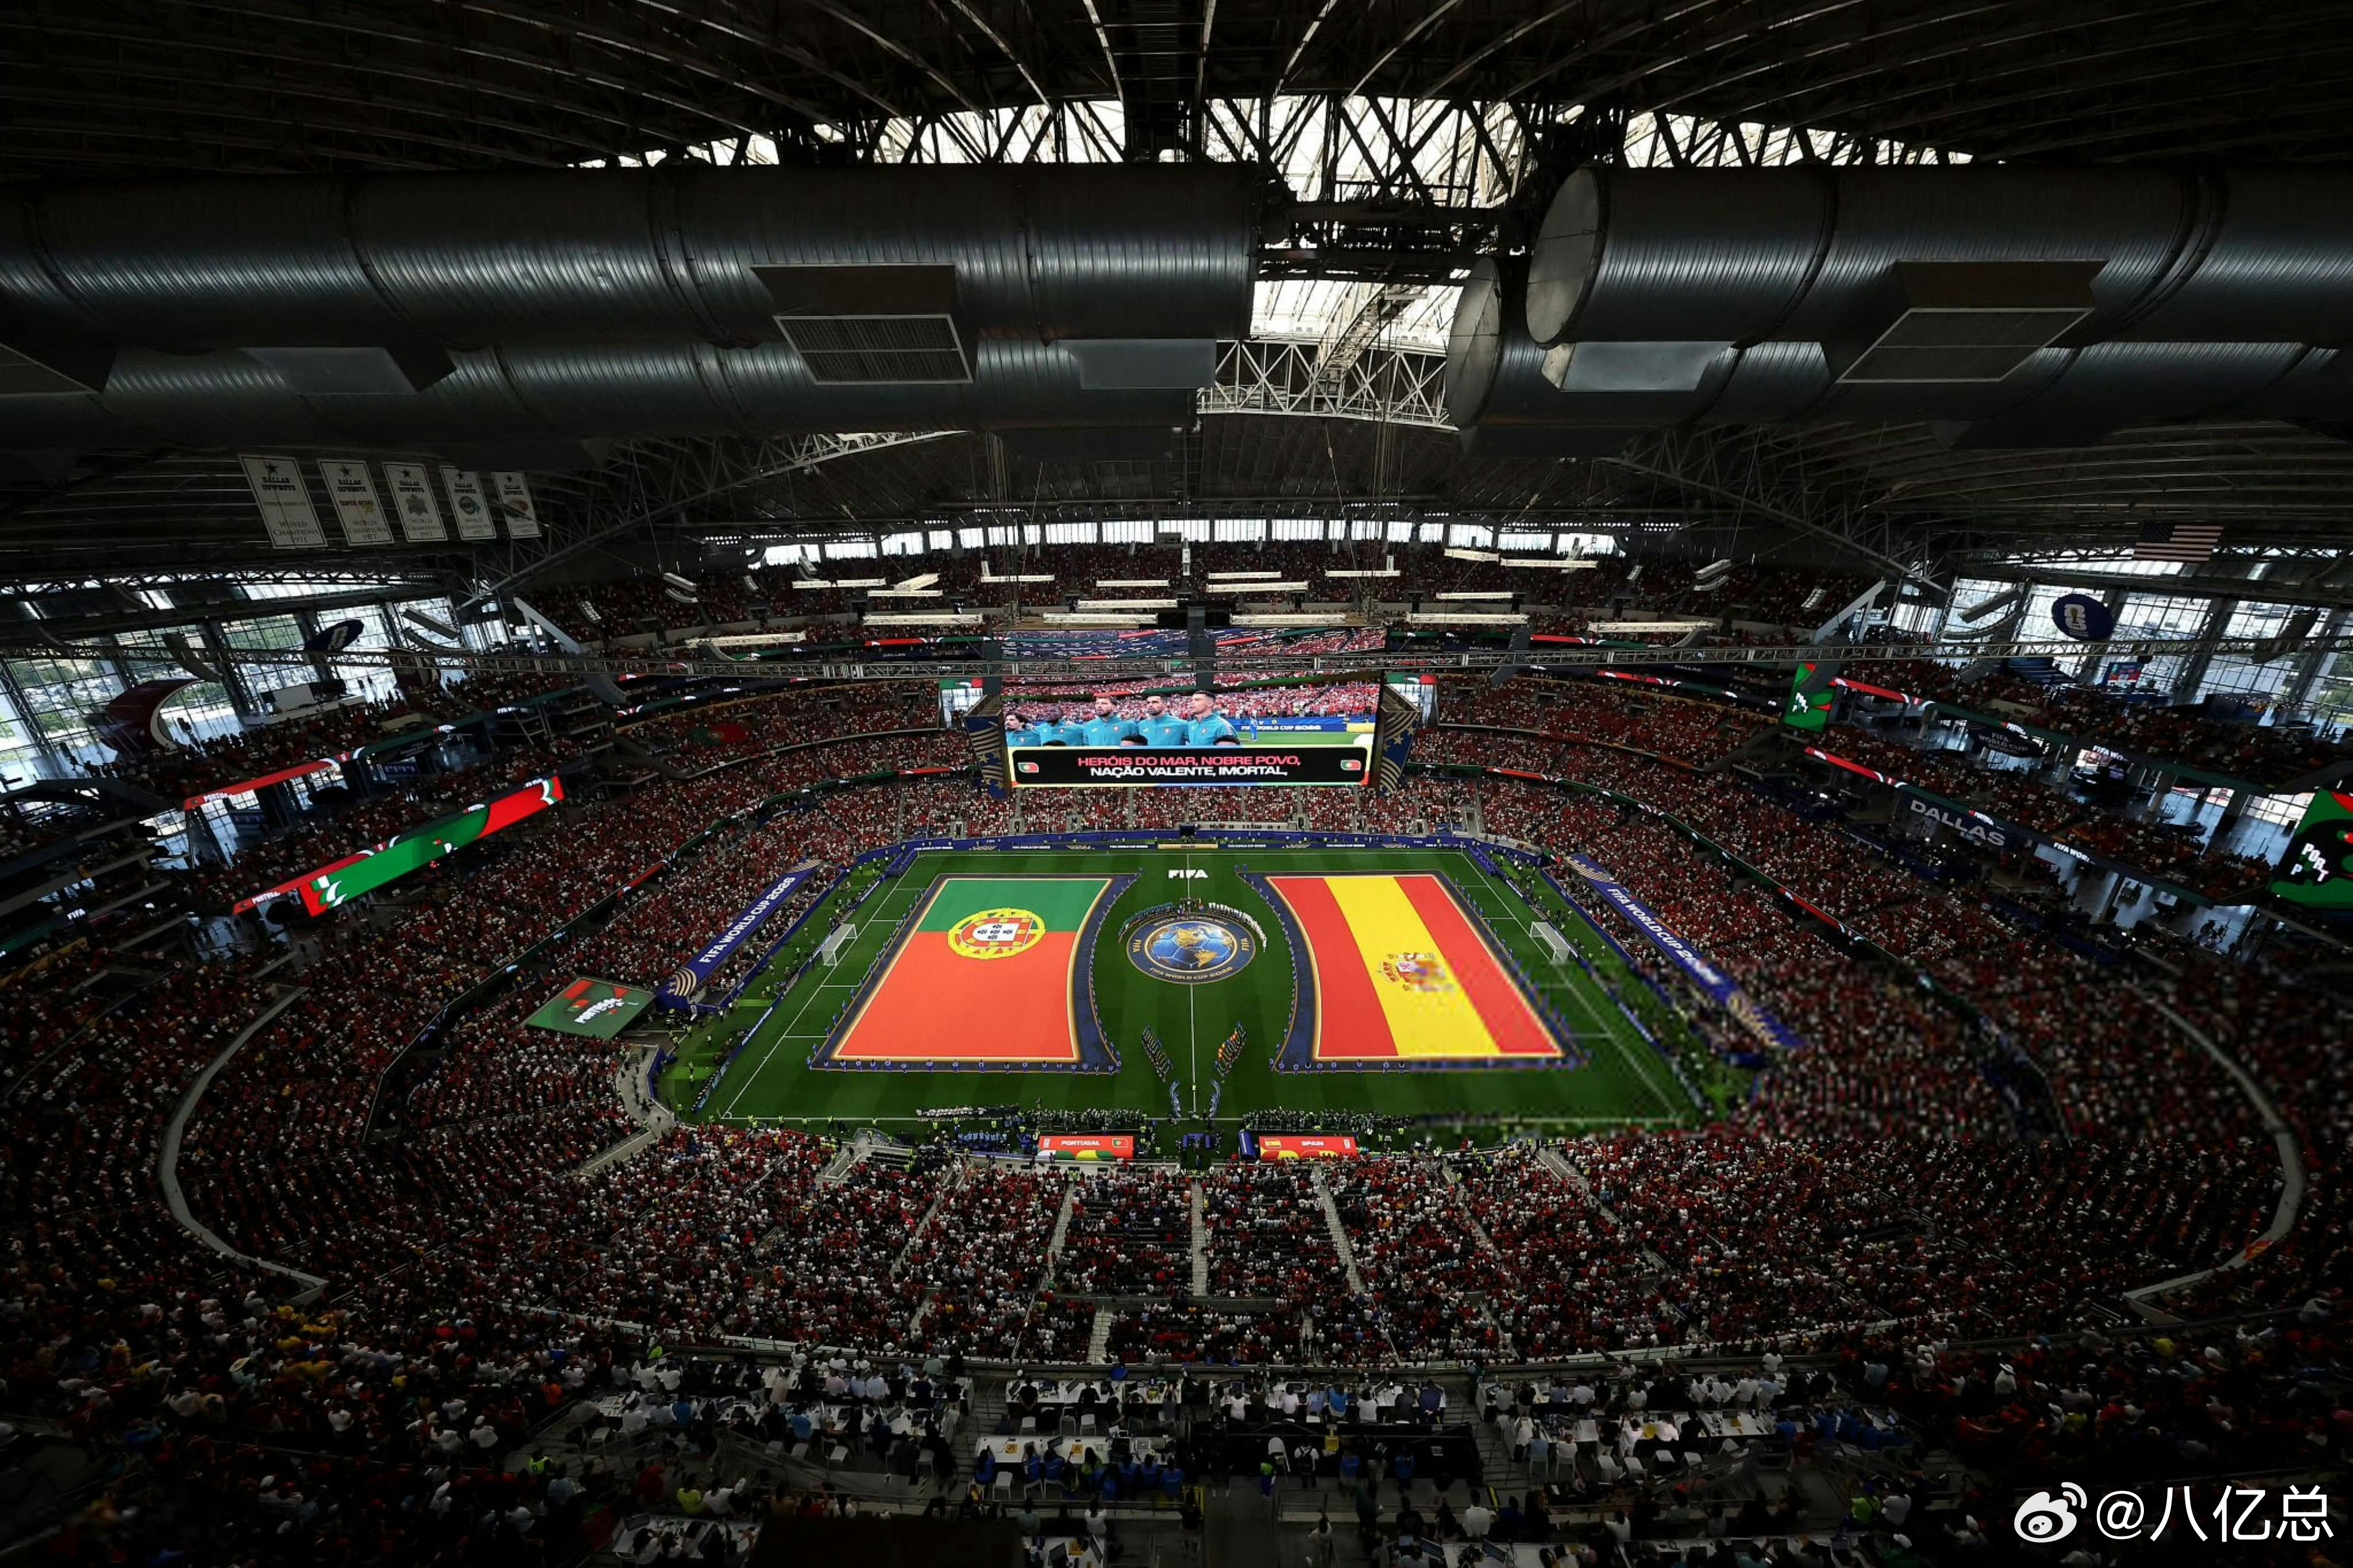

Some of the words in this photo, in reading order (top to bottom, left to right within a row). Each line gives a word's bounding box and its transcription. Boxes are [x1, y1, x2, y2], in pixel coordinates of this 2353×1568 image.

[1078, 755, 1132, 766] HERÓIS
[1135, 756, 1158, 766] DO
[1160, 756, 1198, 767] MAR,
[1201, 756, 1253, 766] NOBRE
[1255, 755, 1301, 766] POVO,
[1090, 766, 1145, 778] NAÇÃO
[1147, 766, 1217, 777] VALENTE,
[1218, 766, 1288, 776] IMORTAL,
[1910, 799, 2006, 847] DALLAS
[1168, 869, 1209, 878] FIFA
[1607, 888, 1631, 905] FIFA
[1625, 903, 1663, 932] WORLD
[1656, 931, 1683, 950] CUP
[699, 944, 728, 963] FIFA
[719, 916, 755, 944] WORLD
[750, 900, 770, 915] CUP
[1132, 939, 1142, 953] FIFA
